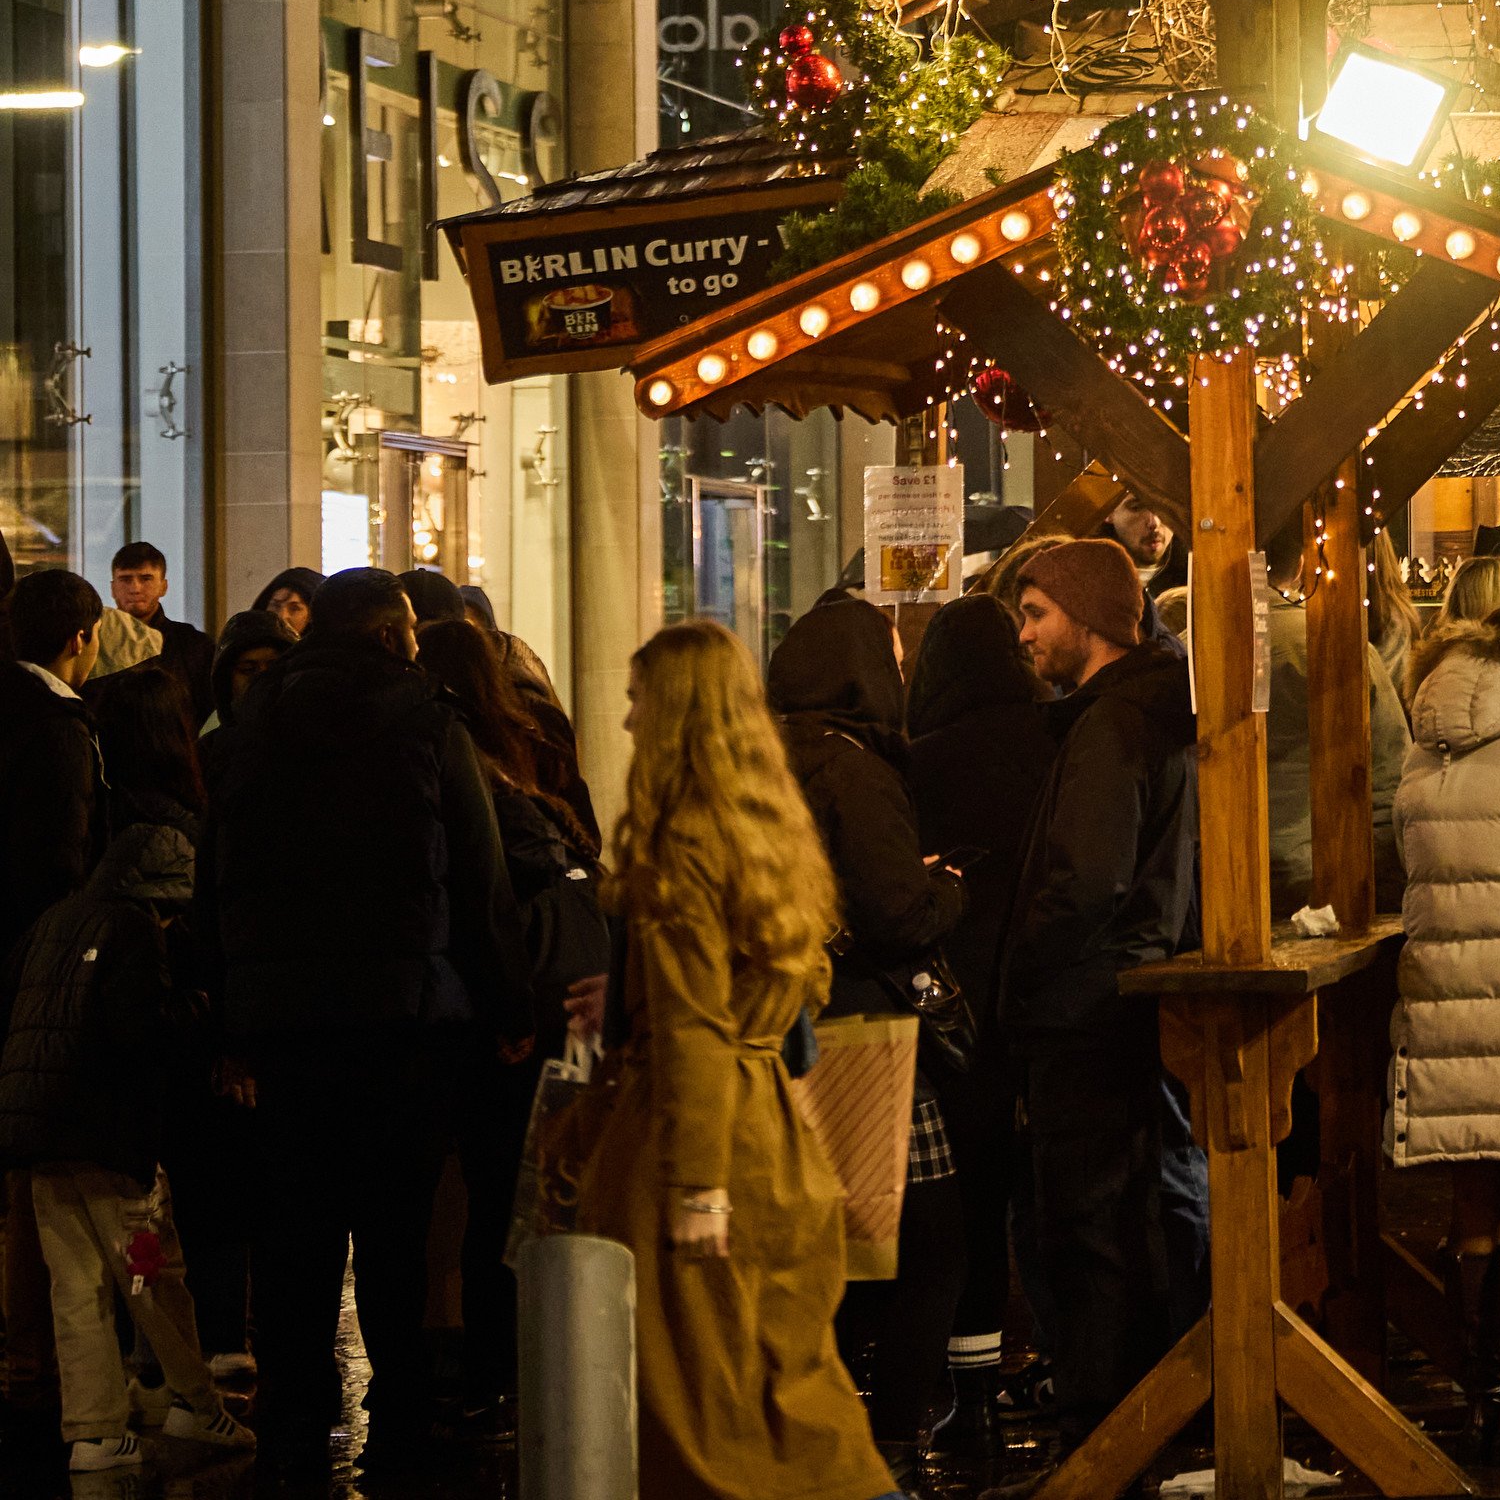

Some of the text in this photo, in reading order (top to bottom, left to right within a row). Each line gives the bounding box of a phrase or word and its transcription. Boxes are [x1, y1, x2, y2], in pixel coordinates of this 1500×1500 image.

[644, 235, 748, 267] Curry
[667, 272, 738, 297] to go
[892, 475, 937, 486] Save £1
